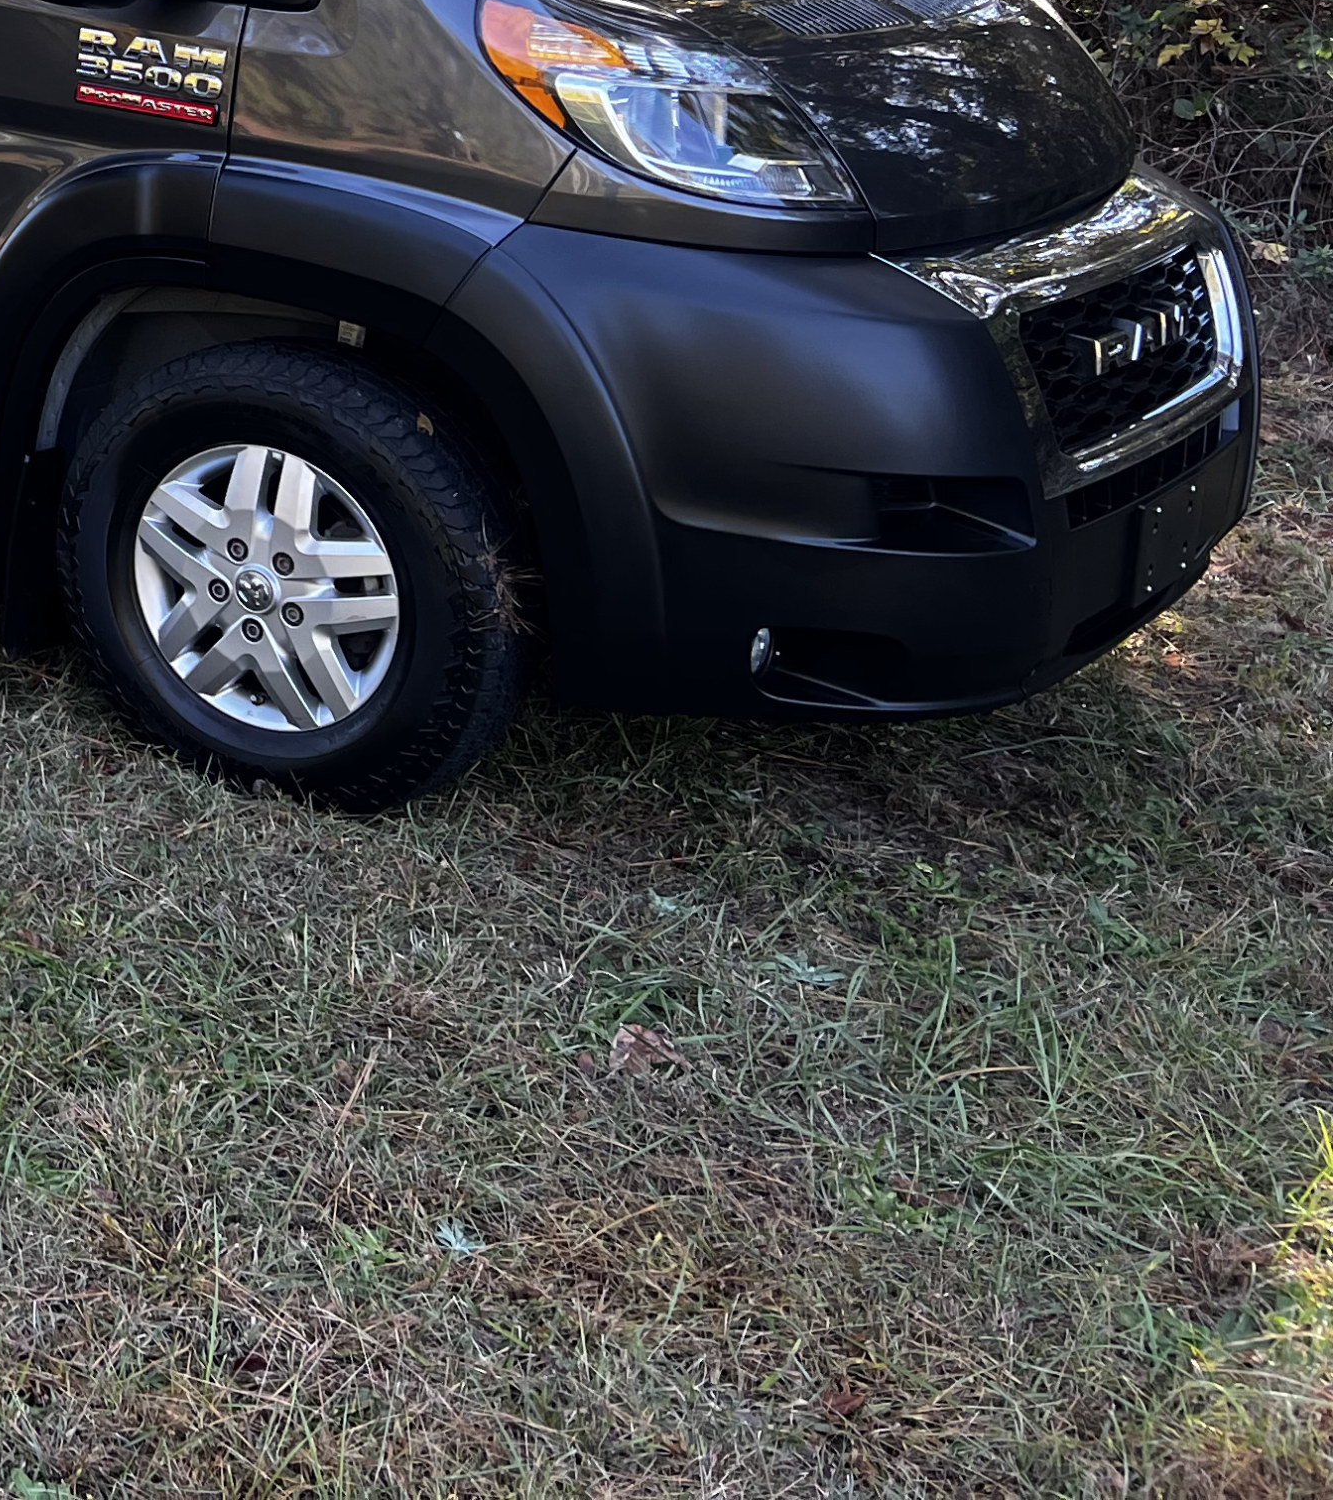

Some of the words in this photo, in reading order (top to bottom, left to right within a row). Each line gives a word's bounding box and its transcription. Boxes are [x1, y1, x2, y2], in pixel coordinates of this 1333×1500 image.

[79, 27, 227, 74] RAM
[76, 53, 222, 100] 3500
[1077, 300, 1185, 377] RAM
